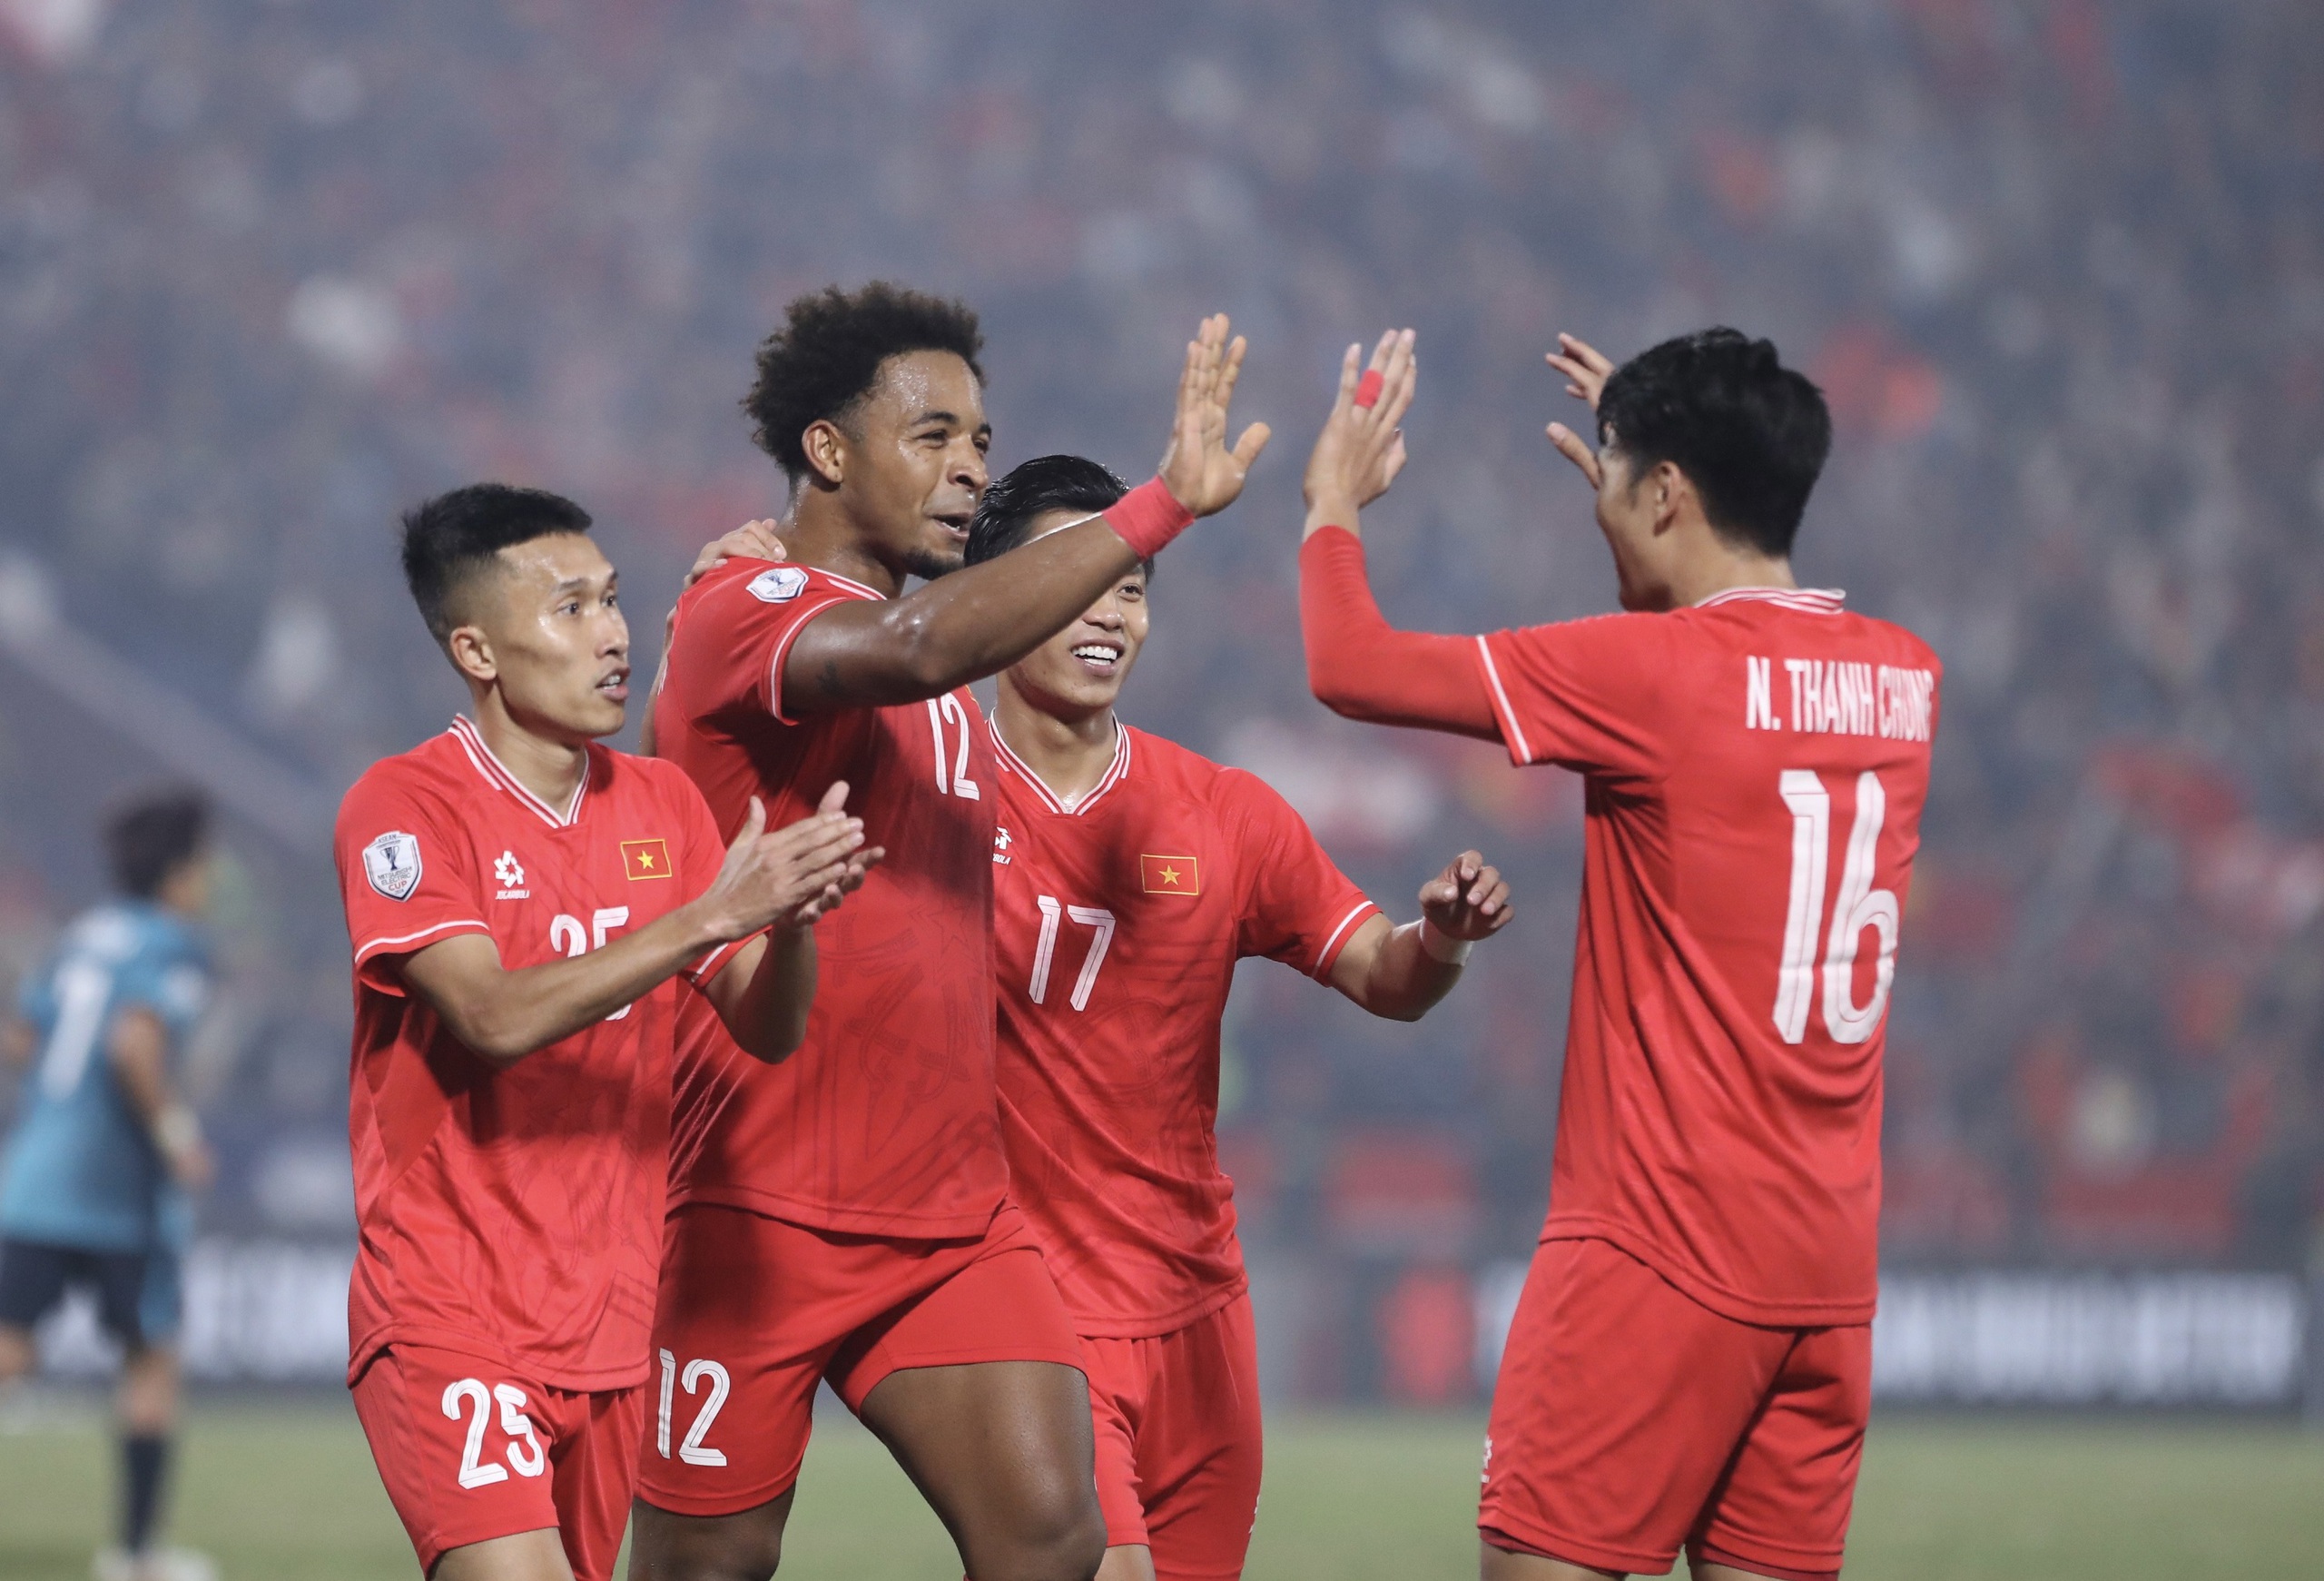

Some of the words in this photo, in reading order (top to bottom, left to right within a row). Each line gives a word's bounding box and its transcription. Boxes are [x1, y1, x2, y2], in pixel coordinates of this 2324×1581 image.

[926, 692, 980, 801] 12
[1746, 655, 1781, 731] N.
[1784, 657, 1875, 736] THANH
[388, 880, 407, 891] CUP
[1772, 768, 1900, 1045] 16
[1028, 894, 1117, 1013] 17
[441, 1378, 545, 1490] 25
[656, 1347, 731, 1467] 12
